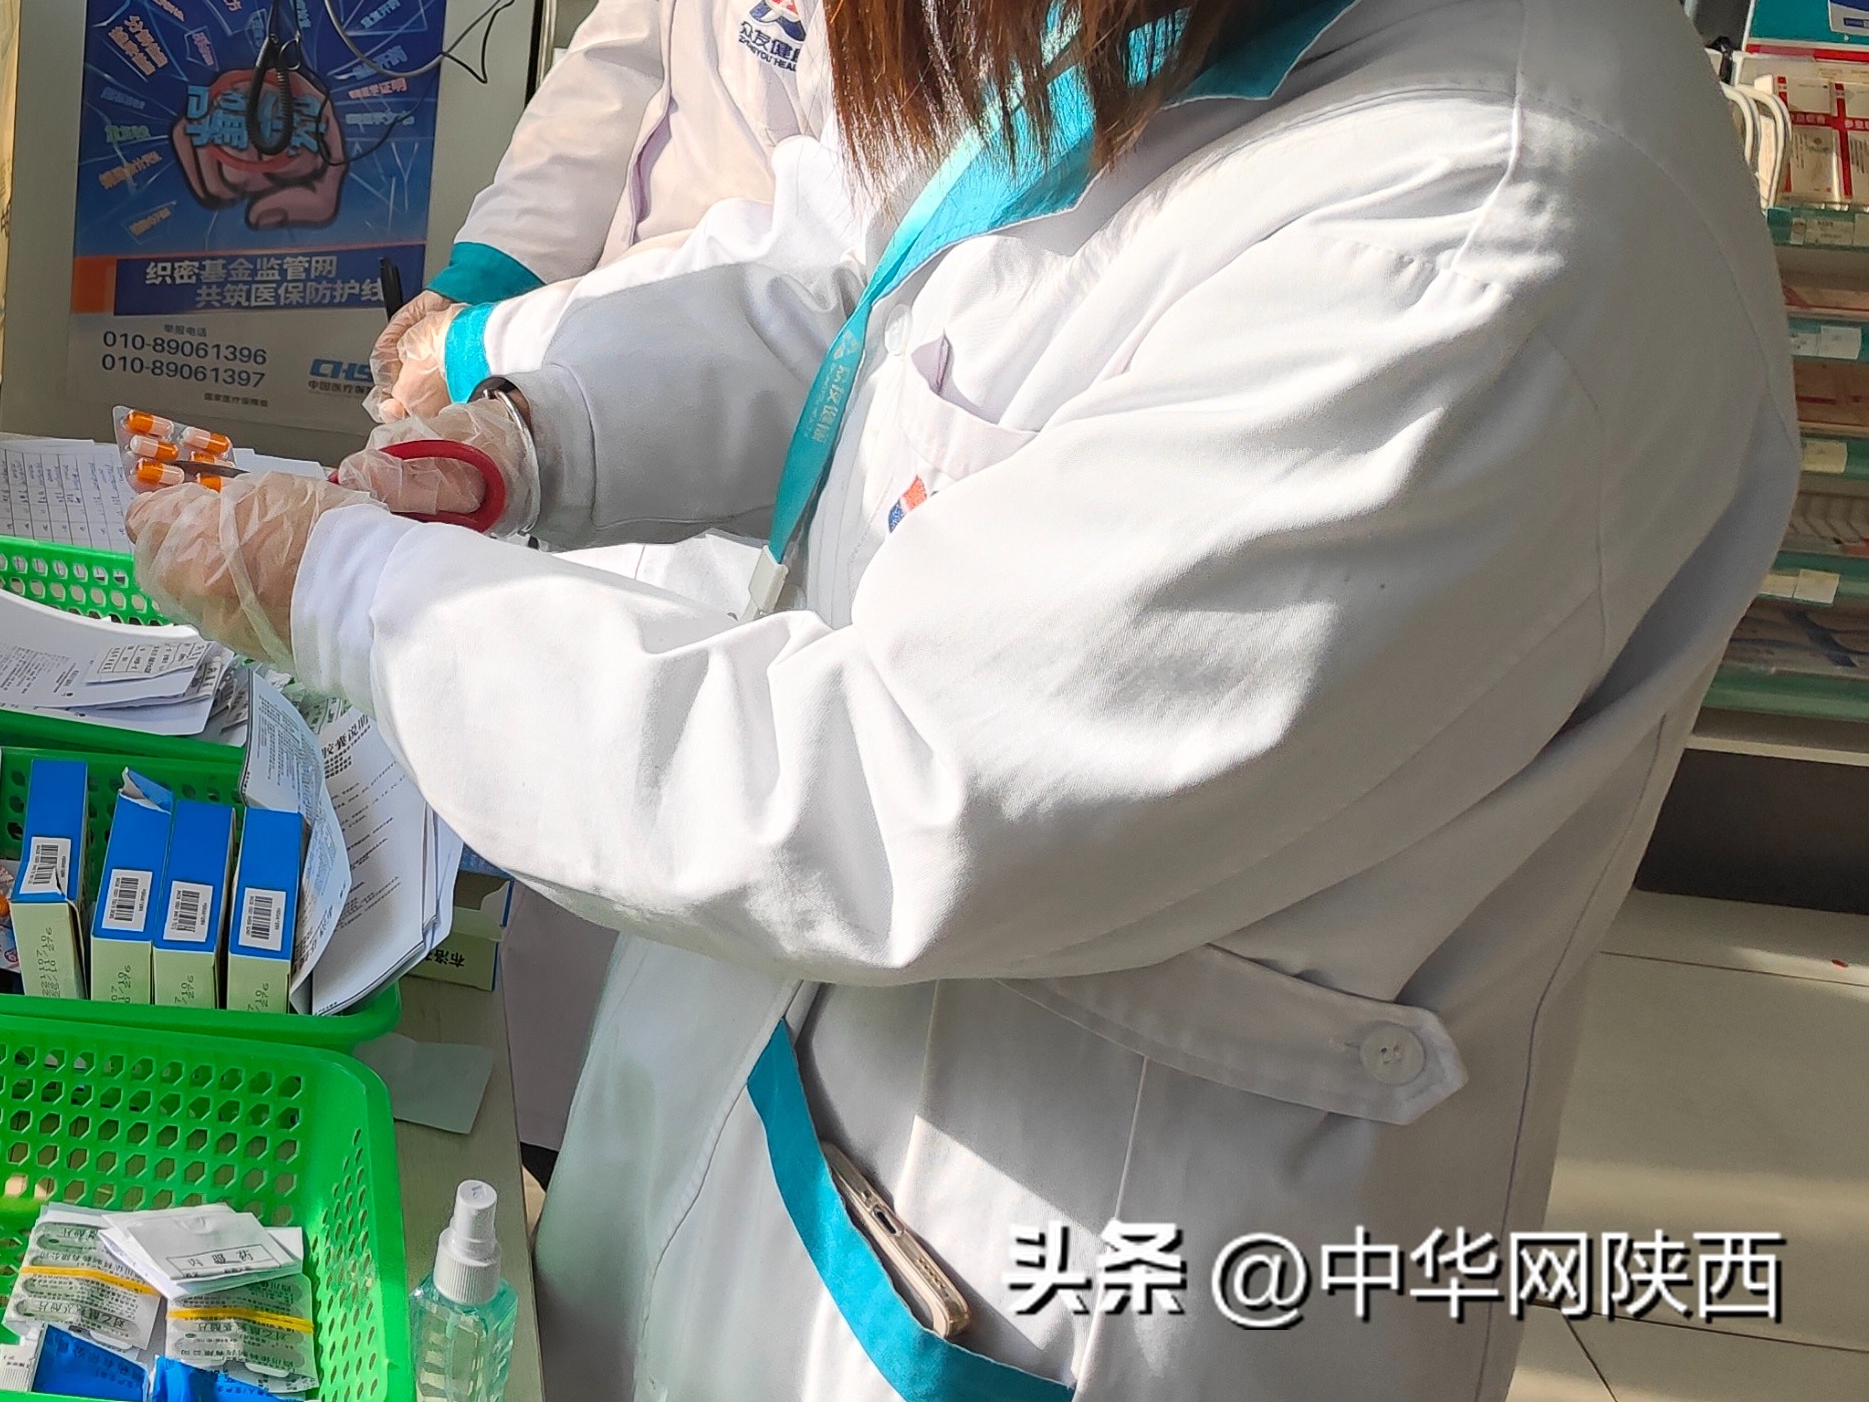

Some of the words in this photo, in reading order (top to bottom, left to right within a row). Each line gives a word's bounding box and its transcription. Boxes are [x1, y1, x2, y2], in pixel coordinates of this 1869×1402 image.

[144, 255, 338, 286] 织密基金监管网
[195, 278, 384, 309] 共筑医保防护线
[163, 323, 208, 338] 举报电话
[103, 330, 268, 366] 010-89061396
[101, 353, 266, 388] 010-89061397
